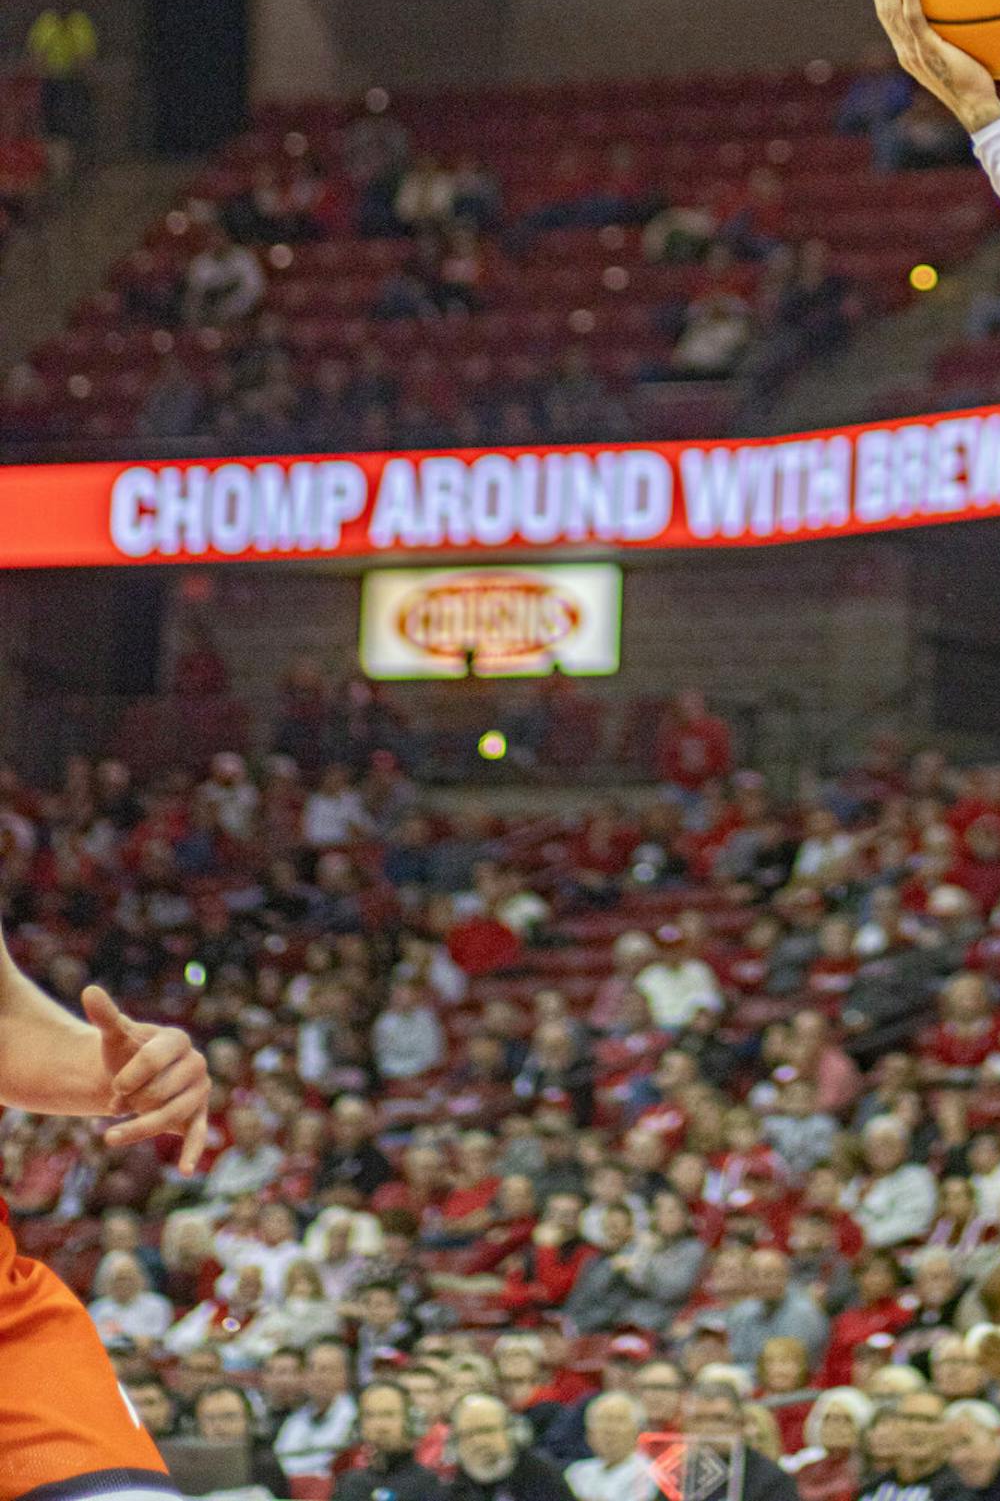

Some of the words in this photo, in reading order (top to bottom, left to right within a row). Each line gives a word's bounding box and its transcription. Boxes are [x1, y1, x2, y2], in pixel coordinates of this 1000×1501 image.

[109, 459, 368, 558] CHOMP
[367, 447, 674, 549] AROUND
[678, 433, 853, 540] WITH
